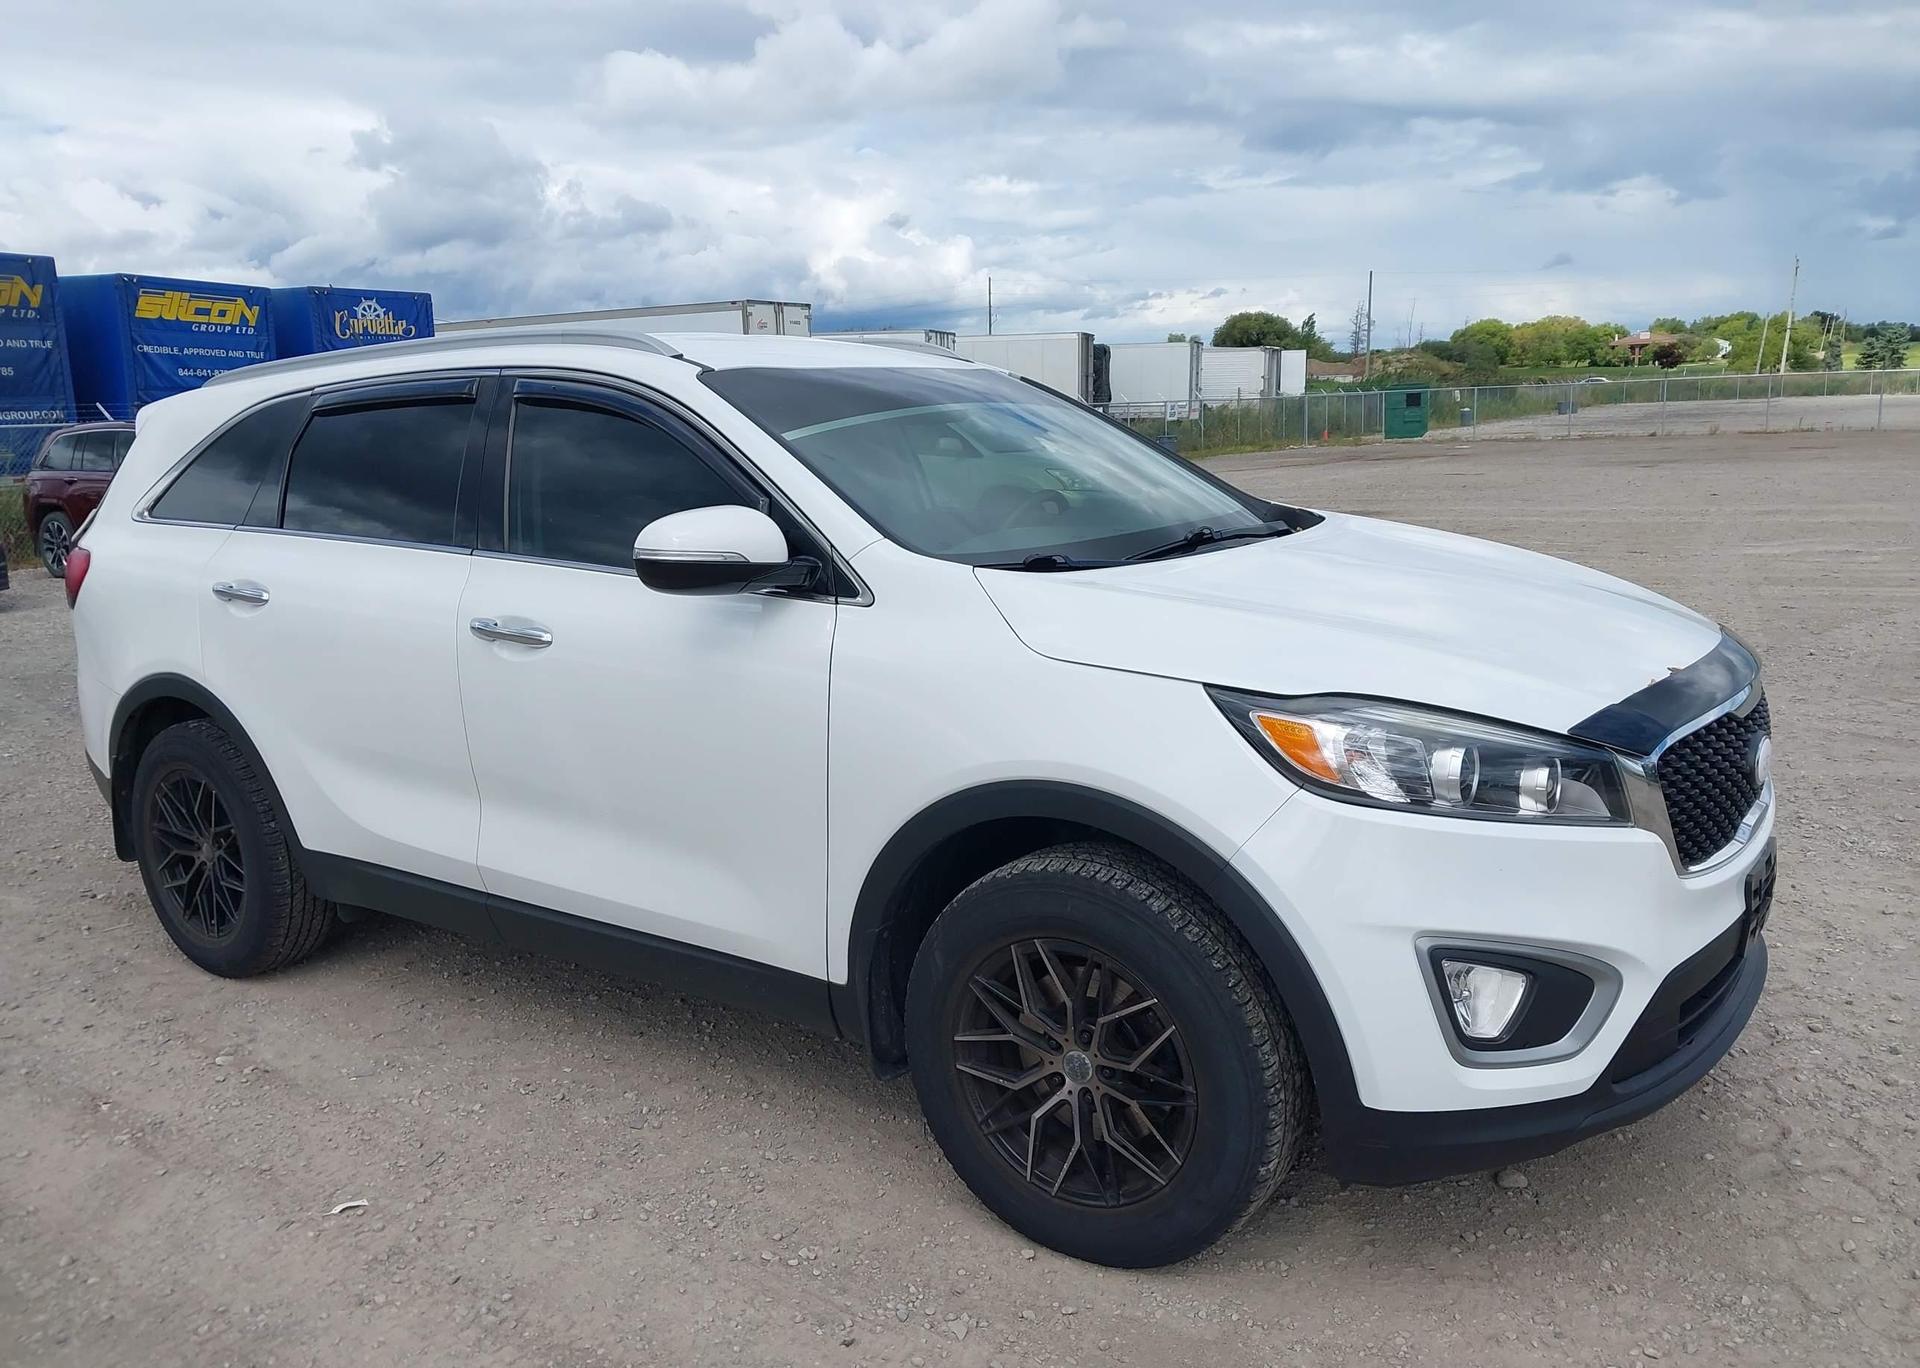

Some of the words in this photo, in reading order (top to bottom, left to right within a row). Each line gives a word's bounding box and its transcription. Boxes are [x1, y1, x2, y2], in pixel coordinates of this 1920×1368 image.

[12, 309, 40, 319] LTD.
[192, 323, 231, 333] GROUP
[334, 310, 416, 339] Corvette
[6, 339, 27, 348] AND
[28, 340, 54, 349] TRUE
[183, 347, 227, 357] APPROVED
[228, 350, 245, 358] AND
[246, 351, 265, 359] TRUE
